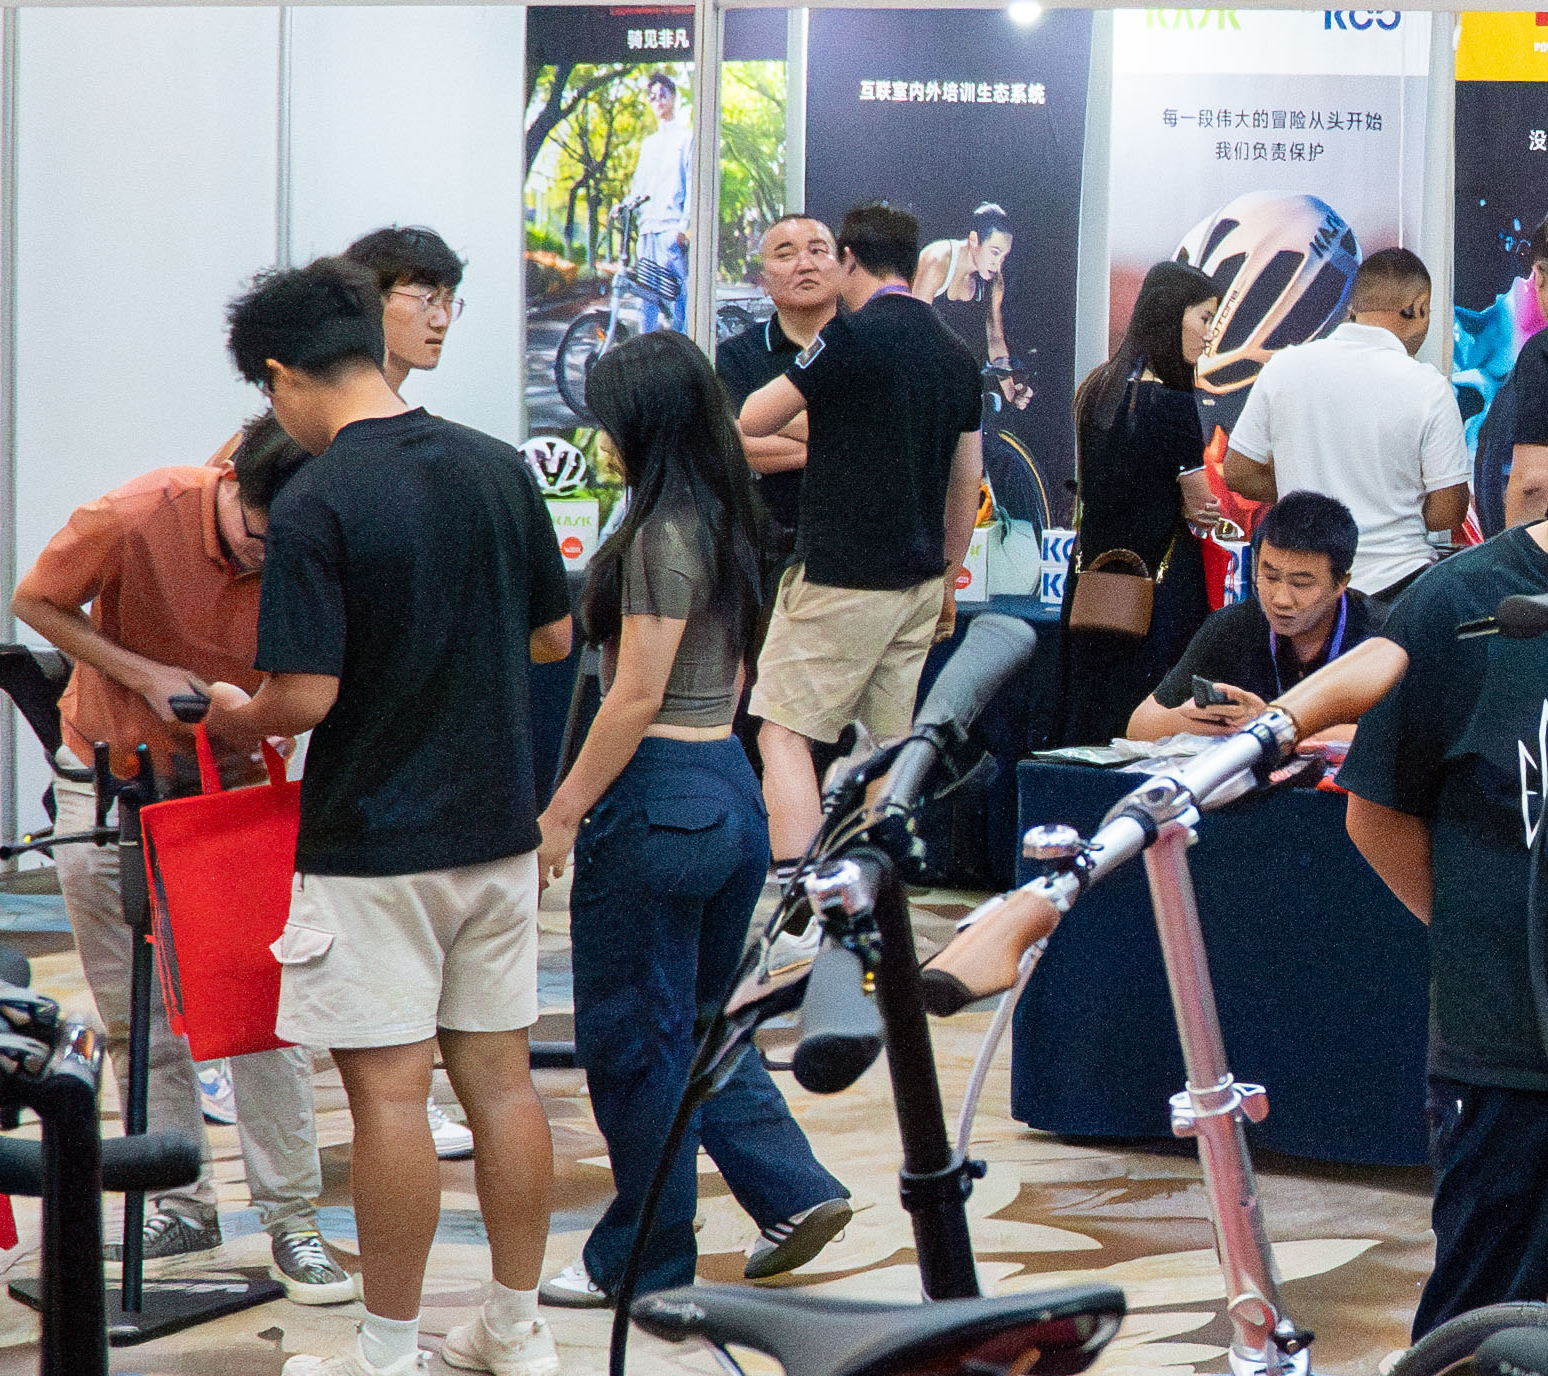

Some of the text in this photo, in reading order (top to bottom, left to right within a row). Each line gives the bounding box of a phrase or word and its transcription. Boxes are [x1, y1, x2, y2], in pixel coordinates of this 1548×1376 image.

[858, 79, 1047, 106] 互联室内外培训生态系统
[1162, 109, 1383, 132] 每一段伟大的冒险从头开始
[1215, 141, 1325, 162] 我们负责保护
